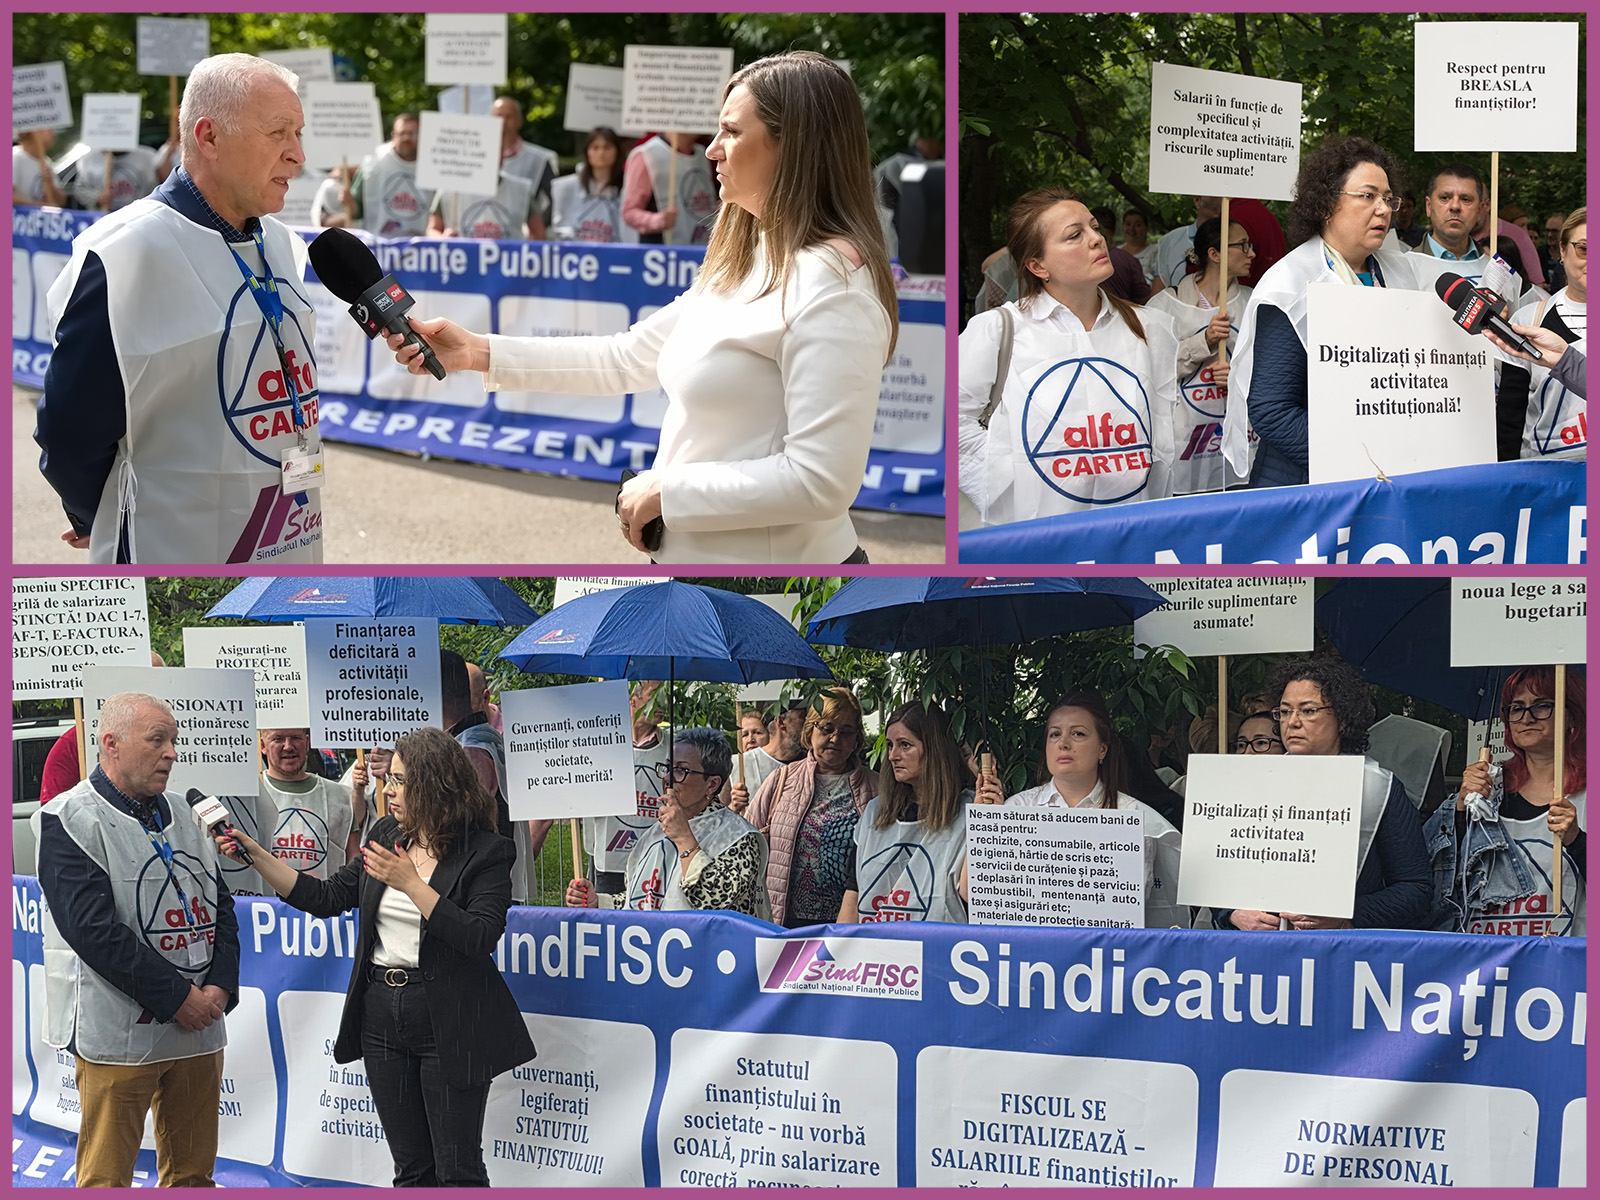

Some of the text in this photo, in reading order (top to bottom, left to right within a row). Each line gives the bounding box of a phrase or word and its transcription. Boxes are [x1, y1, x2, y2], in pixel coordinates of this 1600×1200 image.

[1447, 61, 1546, 77] Respect pentru
[1460, 79, 1532, 92] BREASLA
[1174, 89, 1283, 114] Salarii în funcție de
[1455, 96, 1536, 113] finanțiștilor!
[1197, 112, 1260, 130] specificul și
[1158, 125, 1294, 149] complexitatea activității,
[1165, 142, 1287, 163] riscurile suplimentare
[1204, 163, 1253, 176] asumate!
[377, 240, 598, 282] inanțe Publice
[1458, 296, 1477, 325] REALITATEA
[1467, 304, 1481, 324] PLUS
[1320, 345, 1486, 368] Digitalizați și finanțați
[258, 350, 313, 401] afa
[1371, 373, 1448, 389] activitatea
[1356, 397, 1461, 418] instituțională!
[1064, 412, 1137, 450] alfa
[1052, 449, 1152, 478] CARTEL
[12, 578, 135, 593] meniu SPECIFIC,
[1462, 583, 1586, 600] noua lege a sa
[44, 597, 59, 608] de
[62, 595, 126, 607] salarizare
[1208, 594, 1297, 612] suplimentare
[12, 610, 145, 626] STINCTĂ! DAC 1-7,
[1506, 602, 1587, 622] bugetaril
[1194, 614, 1254, 629] asumate!
[12, 627, 143, 643] AF-T, E-FACTURA,
[336, 624, 415, 641] Finanțarea
[102, 645, 124, 654] etc.
[218, 645, 287, 656] Asigurați-ne
[330, 644, 416, 659] deficitară a
[52, 664, 67, 673] nu
[216, 658, 291, 669] PROTECȚIE
[275, 672, 301, 680] reală
[339, 665, 408, 684] activității
[326, 686, 423, 703] profesionale,
[322, 707, 429, 721] vulnerabilitate
[512, 714, 621, 734] Guvernanți, conferiți
[193, 734, 251, 748] cerințele
[510, 732, 626, 752] finanțiștilor statutul în
[202, 751, 248, 763] fiscale!
[545, 755, 592, 767] societate,
[528, 769, 612, 789] pe care-l merită!
[970, 809, 1139, 826] Ne-am săturat să aducem bani de
[1193, 803, 1351, 824] Digitalizați și finanțați
[970, 823, 1037, 835] acasă pentru:
[1230, 826, 1304, 841] activitatea
[277, 836, 315, 848] alfa
[977, 836, 1139, 852] rechizite, consumabile, articole
[273, 851, 320, 862] CARTEL
[970, 848, 1113, 865] de igienă, hârtie de scris etc;
[1216, 845, 1316, 863] instituțională!
[976, 862, 1118, 878] servicii de curățenie și pază;
[977, 873, 1139, 891] deplasări în interes de serviciu:
[972, 886, 1140, 905] combustibil, mentenanță auto,
[165, 896, 211, 927] afa
[972, 898, 1071, 914] taxe și asigurări etc;
[977, 911, 1023, 921] materiale
[1025, 913, 1037, 922] de
[1039, 914, 1085, 927] protecție
[1471, 921, 1558, 935] CARTEL
[252, 902, 355, 958] Publi
[499, 921, 693, 989] indFISC
[804, 960, 919, 988] SindFISC
[822, 984, 853, 992] Național
[856, 986, 886, 995] Finanțe
[888, 988, 919, 996] Publice
[948, 939, 1586, 1061] Sindicatul Națio
[330, 1065, 338, 1083] în
[737, 1057, 809, 1080] Statutul
[512, 1067, 599, 1092] Guvernanți,
[320, 1090, 331, 1107] de
[521, 1089, 588, 1119] legiferați
[705, 1084, 841, 1114] finanțistului în
[1001, 1093, 1106, 1121] FISCUL SE
[516, 1116, 589, 1143] STATUTUL
[684, 1112, 866, 1146] societate nu vorbă
[963, 1120, 1128, 1155] DIGITALIZEAZĂ
[1298, 1120, 1445, 1150] NORMATIVE
[494, 1140, 604, 1175] FINANȚISTULUI!
[674, 1136, 880, 1176] GOALĂ, prin salarizare
[932, 1148, 1040, 1177] SALARIILE
[1284, 1152, 1454, 1186] DE PERSONAL
